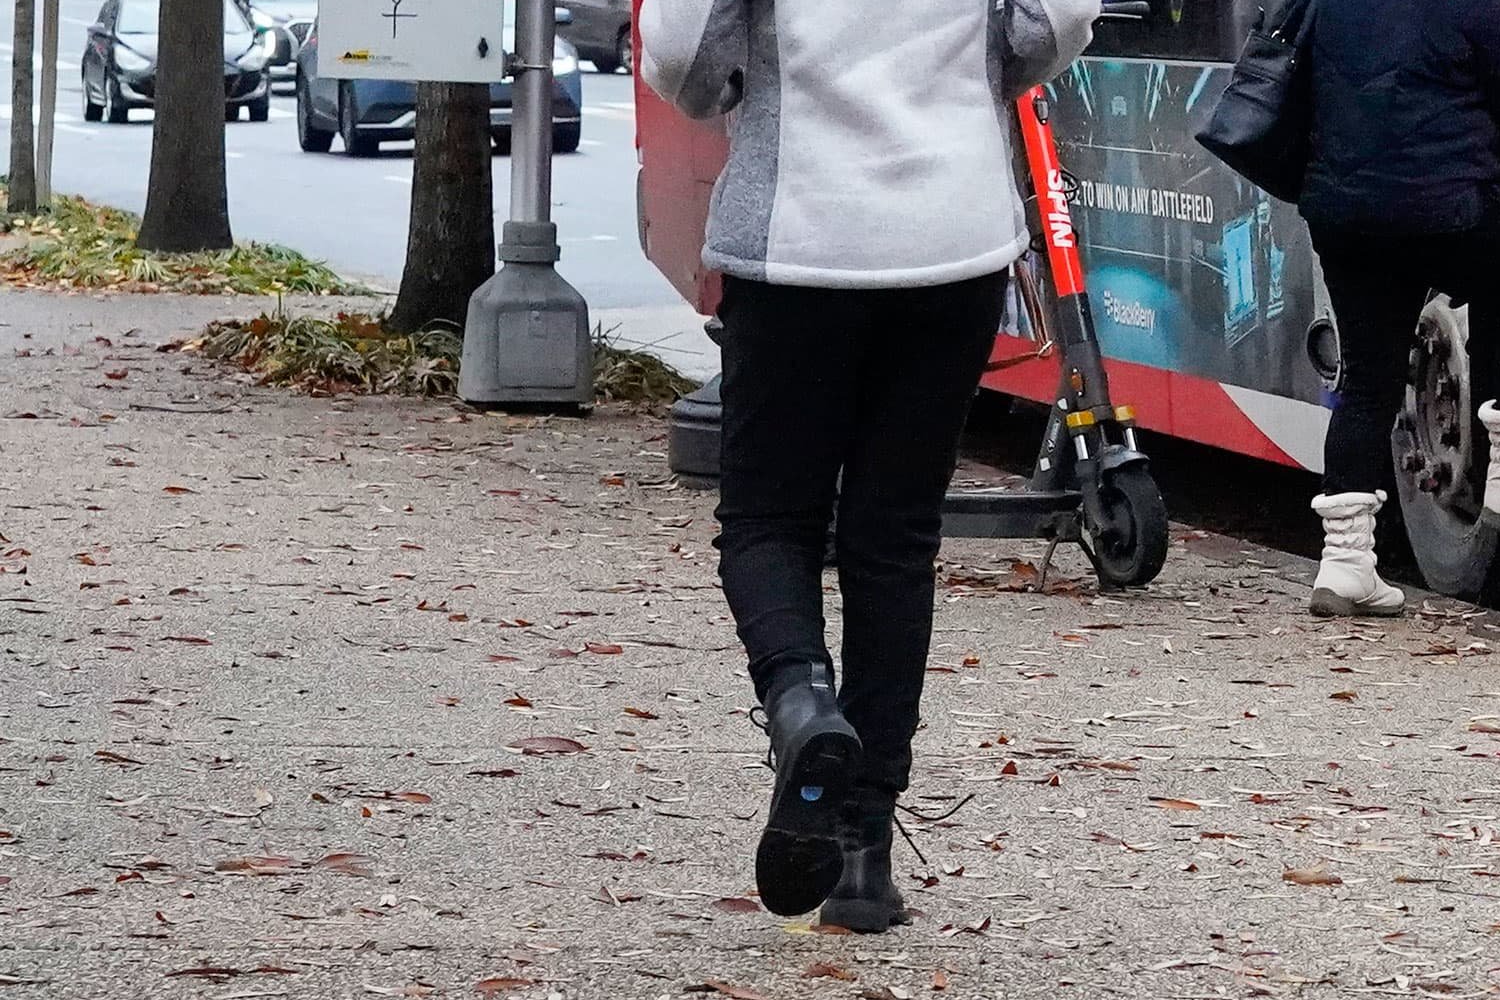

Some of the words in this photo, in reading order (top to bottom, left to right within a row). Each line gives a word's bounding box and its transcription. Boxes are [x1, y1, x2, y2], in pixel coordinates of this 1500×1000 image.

[1047, 168, 1074, 249] SPIN
[1081, 180, 1095, 208] TO
[1096, 181, 1114, 211] WIN
[1115, 184, 1129, 213] ON
[1131, 186, 1150, 216] ANY
[1151, 188, 1215, 225] BATTLEFIELD
